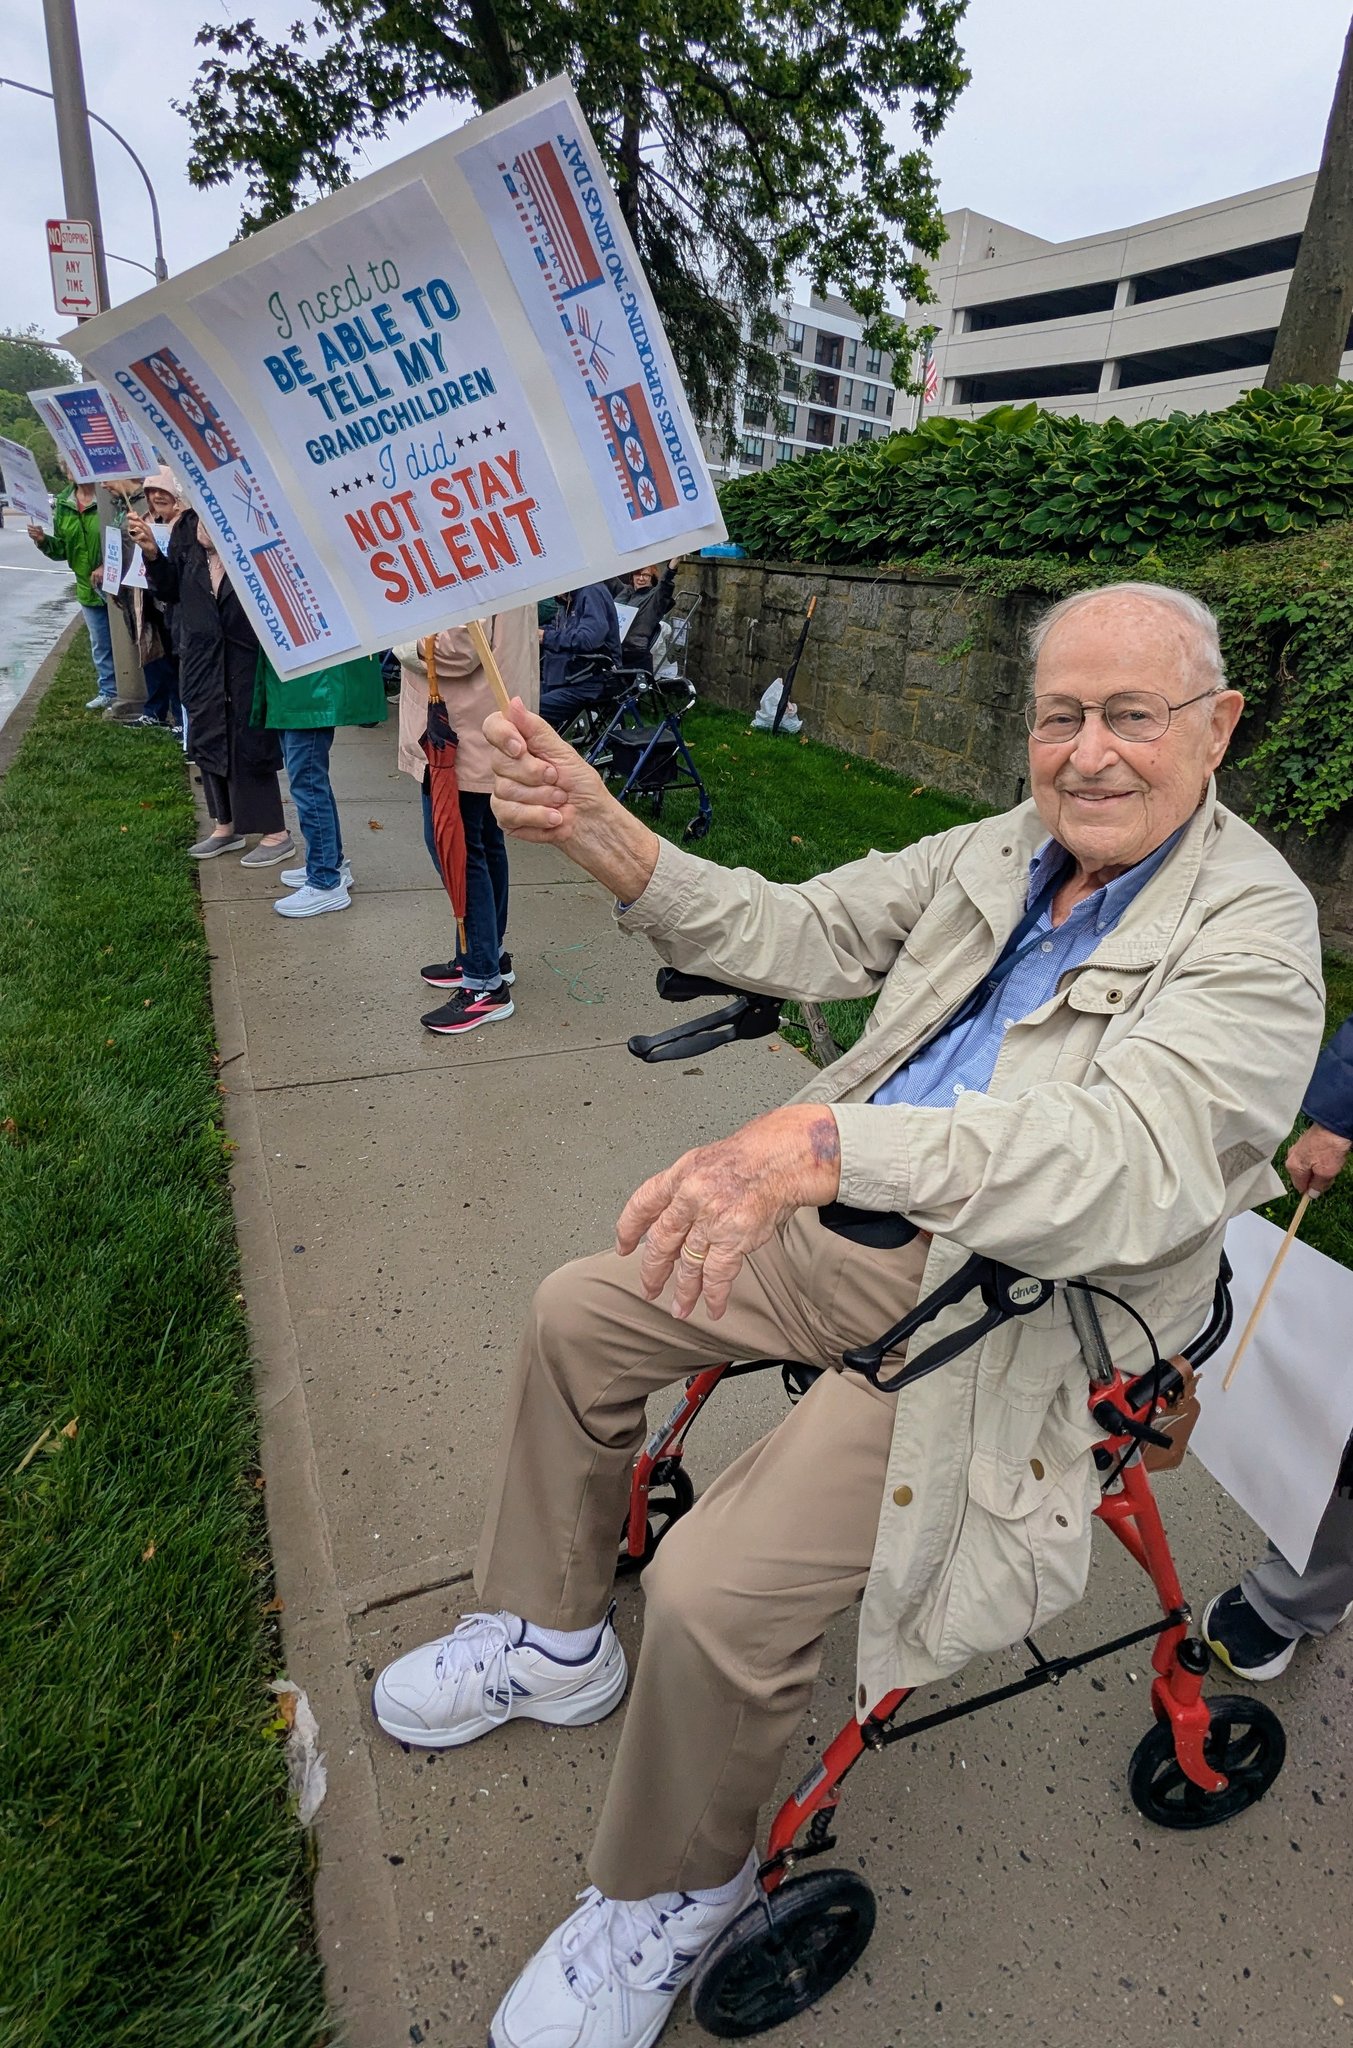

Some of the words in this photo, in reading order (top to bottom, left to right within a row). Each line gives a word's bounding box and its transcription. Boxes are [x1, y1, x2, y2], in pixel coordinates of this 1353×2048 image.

[48, 227, 61, 246] NO
[62, 232, 89, 244] STOPPING
[581, 186, 616, 253] KINGS
[65, 260, 81, 274] ANY
[66, 279, 84, 293] TIME
[268, 291, 293, 339] I
[297, 264, 372, 330] need
[367, 259, 400, 294] to
[263, 345, 315, 395] BE
[317, 302, 406, 373] ABLE
[402, 278, 461, 330] TO
[620, 292, 668, 409] SUPPORTING
[307, 363, 394, 422] TELL
[393, 331, 448, 389] MY
[305, 367, 497, 466] GRANDCHILDREN
[657, 409, 686, 466] FOLKS
[114, 370, 147, 403] OLD
[143, 404, 183, 451] FOLKS
[177, 450, 237, 544] SUPPORTING
[244, 572, 273, 617] KINGS
[379, 443, 396, 489] I
[406, 430, 456, 480] did
[677, 464, 699, 501] OLD
[344, 489, 424, 553] NOT
[430, 449, 527, 521] STAY
[369, 497, 547, 605] SILENT
[1011, 1283, 1039, 1300] drive
